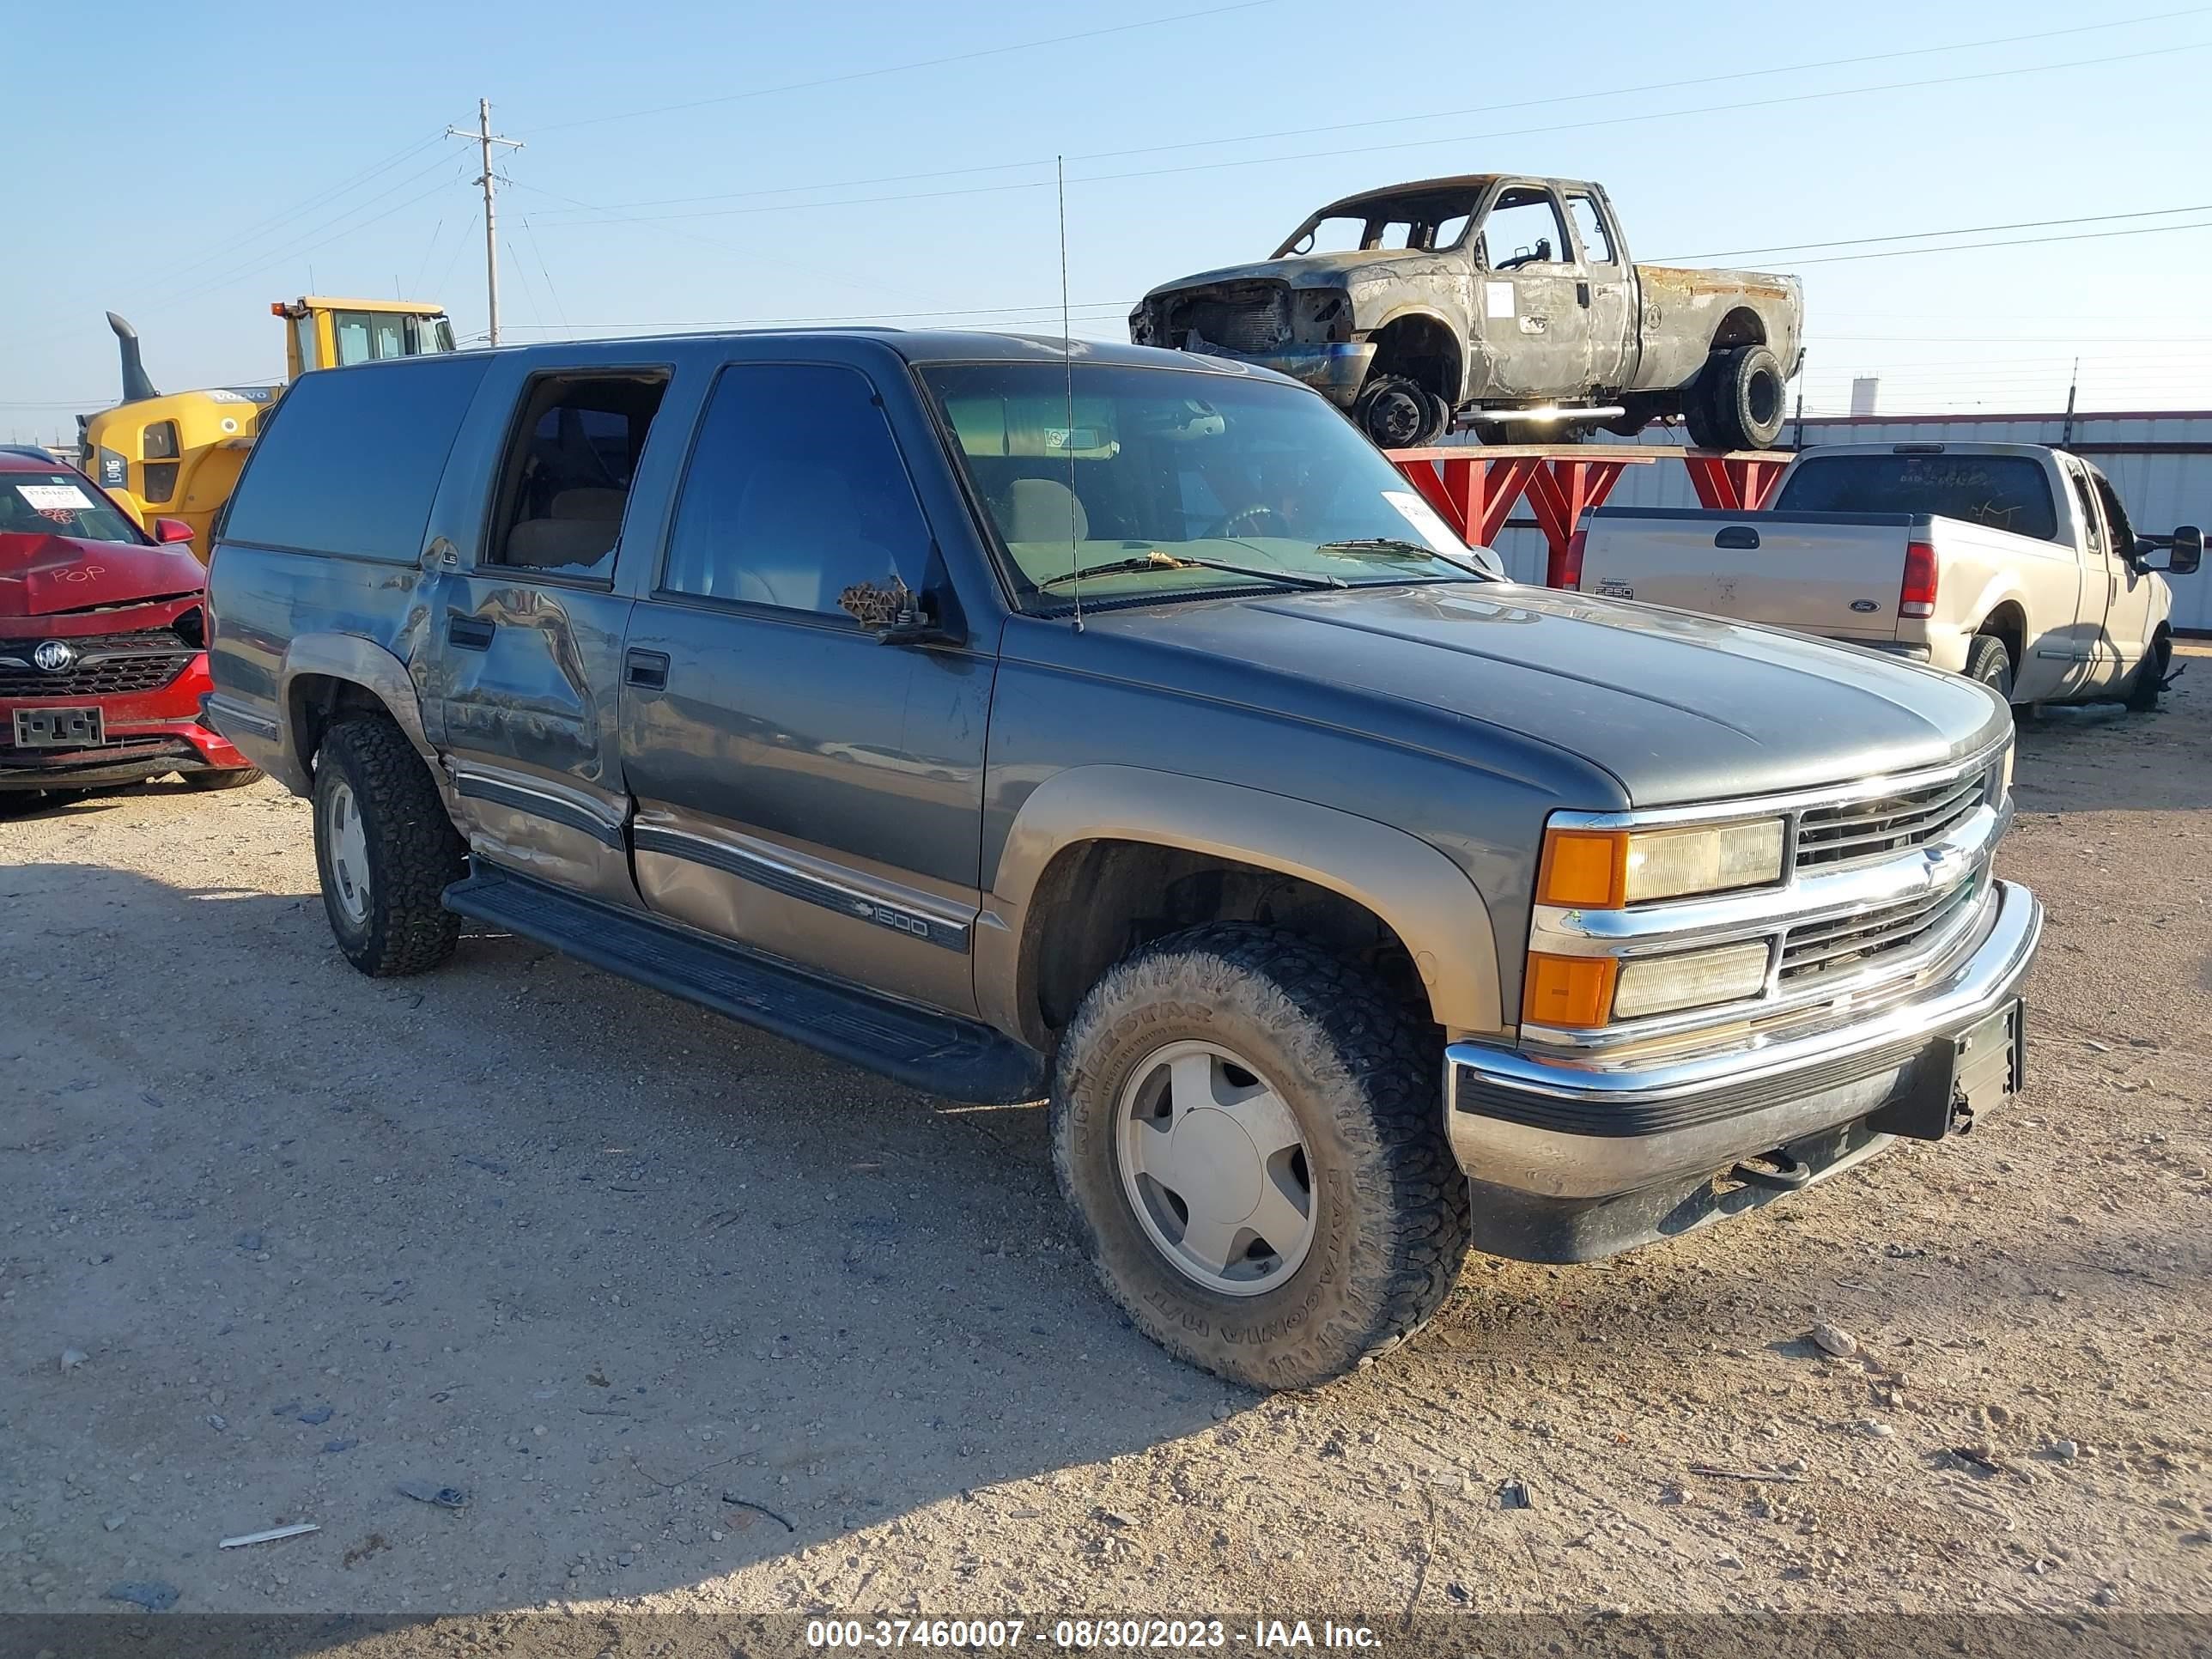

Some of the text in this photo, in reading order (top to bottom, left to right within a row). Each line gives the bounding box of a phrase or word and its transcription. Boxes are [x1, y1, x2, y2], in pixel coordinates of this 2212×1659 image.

[106, 460, 123, 483] L90G
[51, 566, 105, 582] POP
[873, 907, 927, 937] 1500
[1074, 1001, 1213, 1123] MILESTAR
